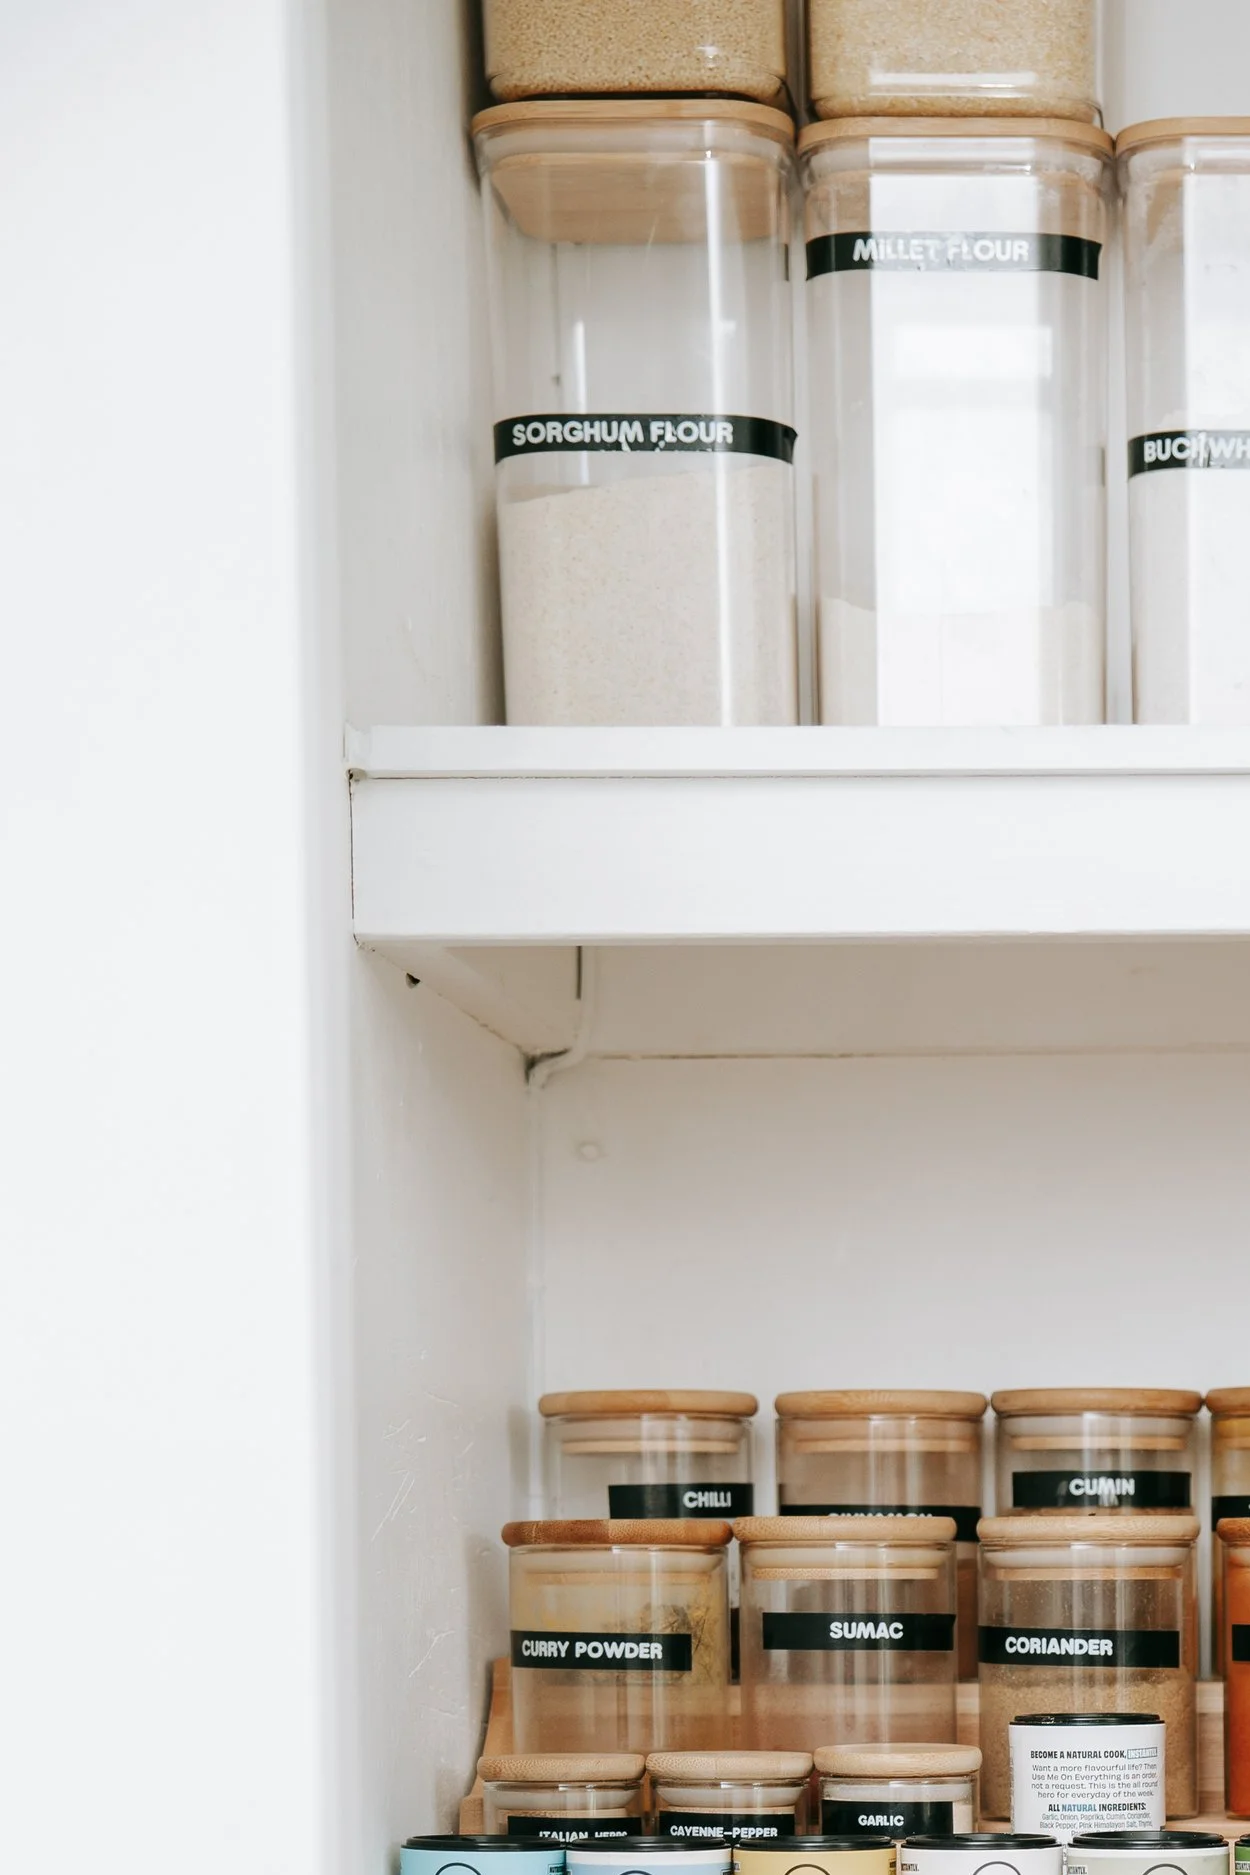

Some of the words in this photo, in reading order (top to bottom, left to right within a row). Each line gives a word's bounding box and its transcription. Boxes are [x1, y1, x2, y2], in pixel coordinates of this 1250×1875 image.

[853, 238, 937, 261] MILLET
[947, 242, 1029, 261] FLOUR
[512, 420, 644, 446] SORGHUM
[650, 420, 733, 445] FLOUR
[1069, 1478, 1135, 1496] CUMIN
[682, 1491, 731, 1509] CHILLI
[829, 1621, 904, 1640] SUMAC
[521, 1640, 569, 1657] CURRY
[575, 1642, 663, 1660] POWDER
[1005, 1637, 1113, 1656] CORIANDER
[1104, 1751, 1126, 1759] COOK,
[1085, 1764, 1126, 1772] flavourful
[1099, 1803, 1146, 1811] INGREDIENTS:
[858, 1814, 904, 1828] GARLIC
[539, 1831, 588, 1842] ITALIAN
[670, 1825, 778, 1838] CAYENNE-PEPPER
